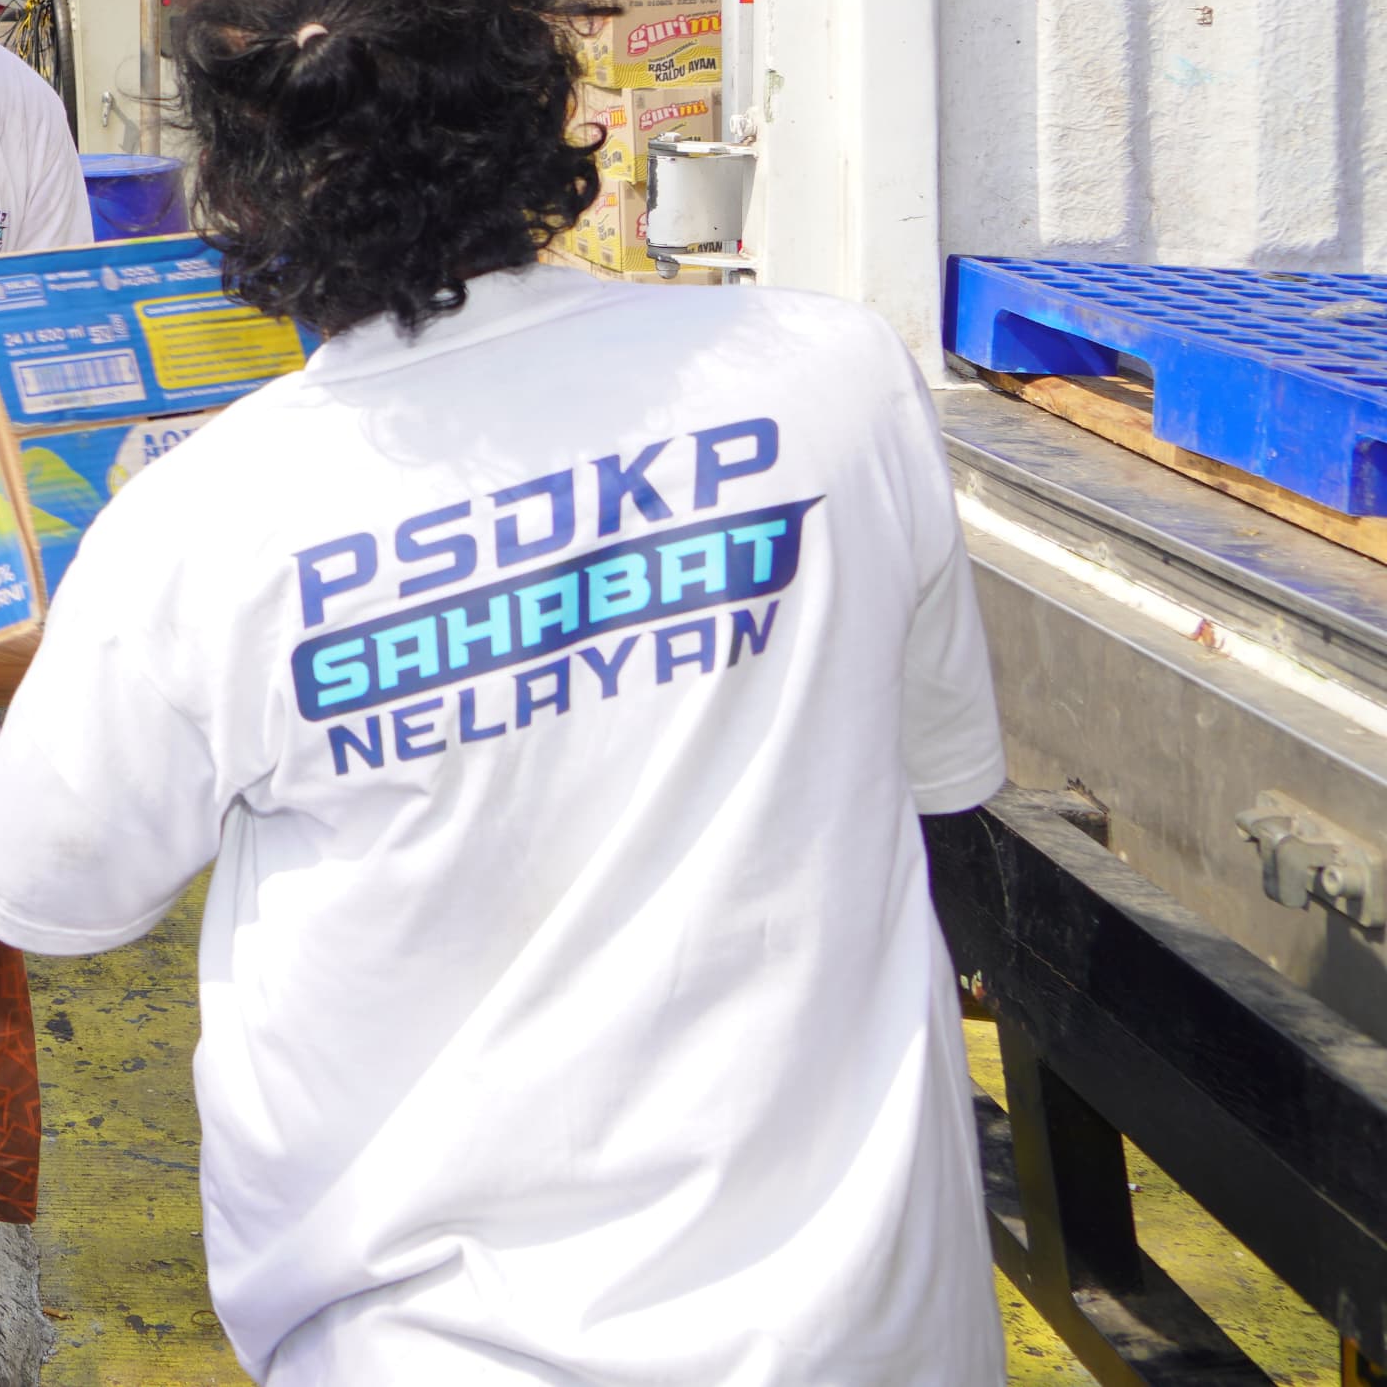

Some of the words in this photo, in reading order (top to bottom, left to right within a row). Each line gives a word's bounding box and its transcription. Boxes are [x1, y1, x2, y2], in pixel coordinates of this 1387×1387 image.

[629, 14, 721, 57] gurim
[648, 58, 675, 72] RASA
[655, 65, 686, 82] KALDU
[688, 58, 717, 73] AYAM
[290, 417, 779, 629] PSDKP
[312, 518, 788, 708] SAHABAT
[327, 600, 781, 776] NELAYAN
